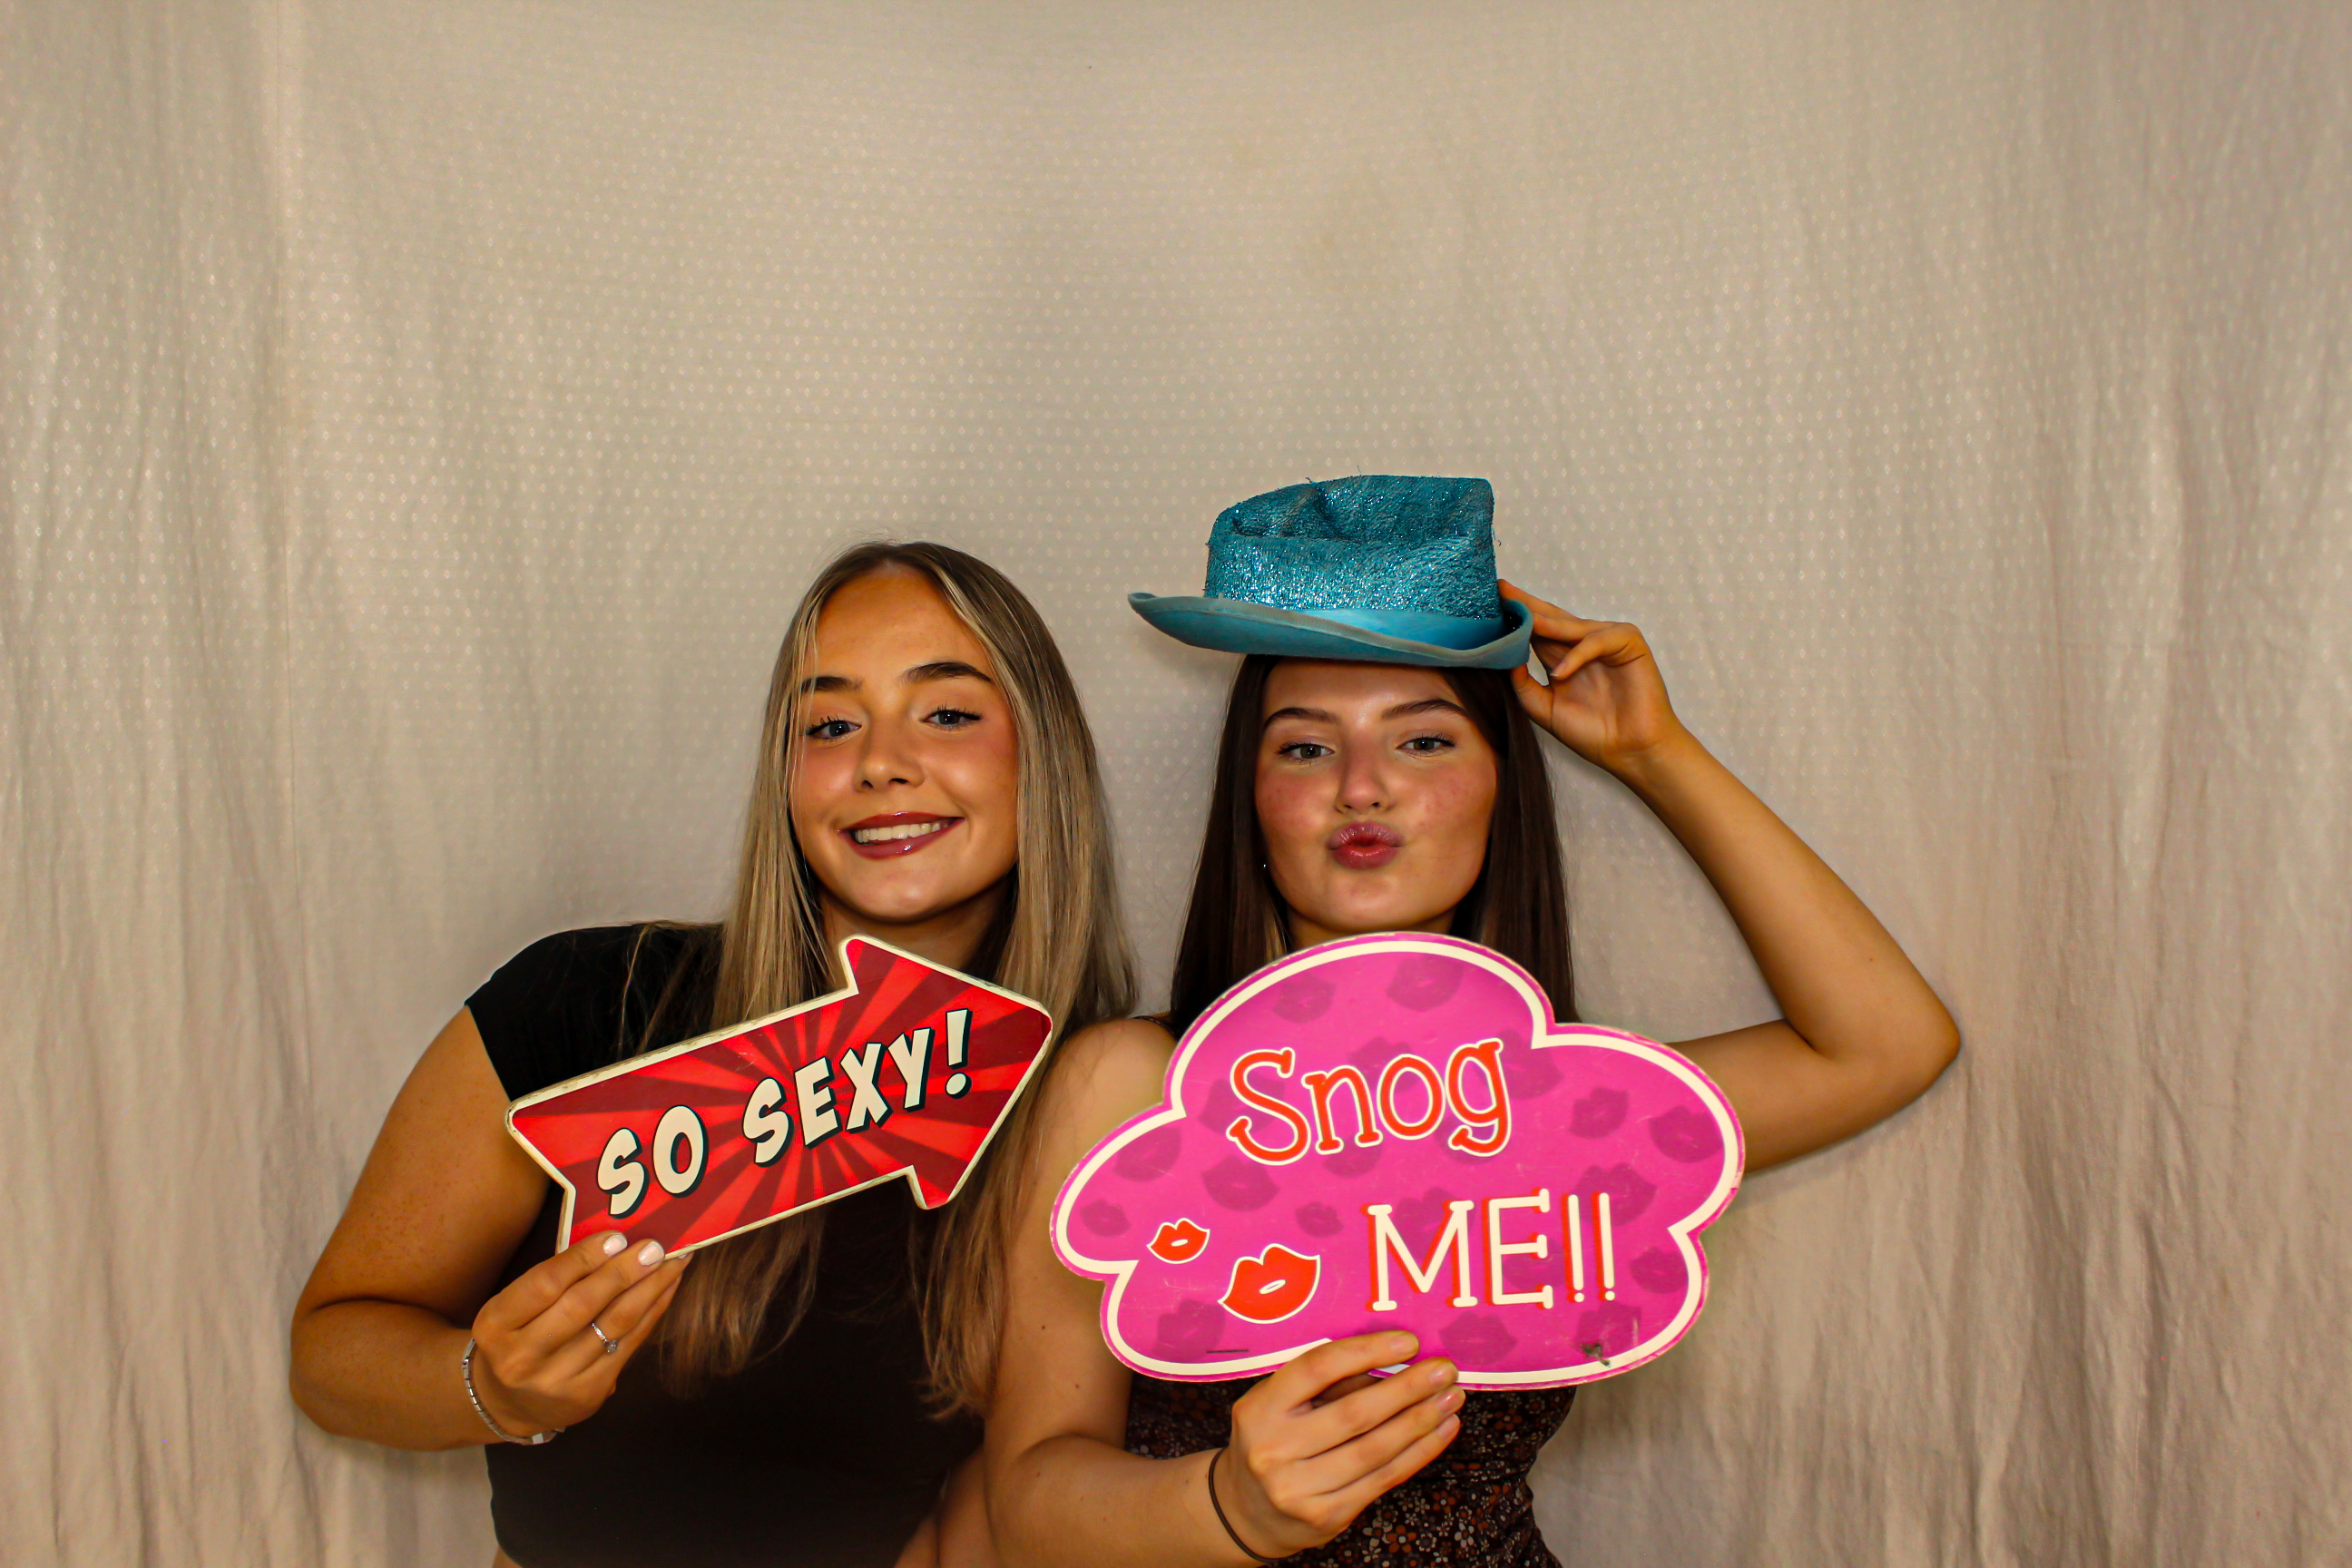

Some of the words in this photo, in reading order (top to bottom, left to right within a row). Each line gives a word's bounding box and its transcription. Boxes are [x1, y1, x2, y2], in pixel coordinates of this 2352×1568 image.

[597, 1104, 709, 1218] SO
[742, 1008, 971, 1166] SEXY!
[1226, 1038, 1511, 1165] Snog
[1362, 1189, 1616, 1310] ME!!
